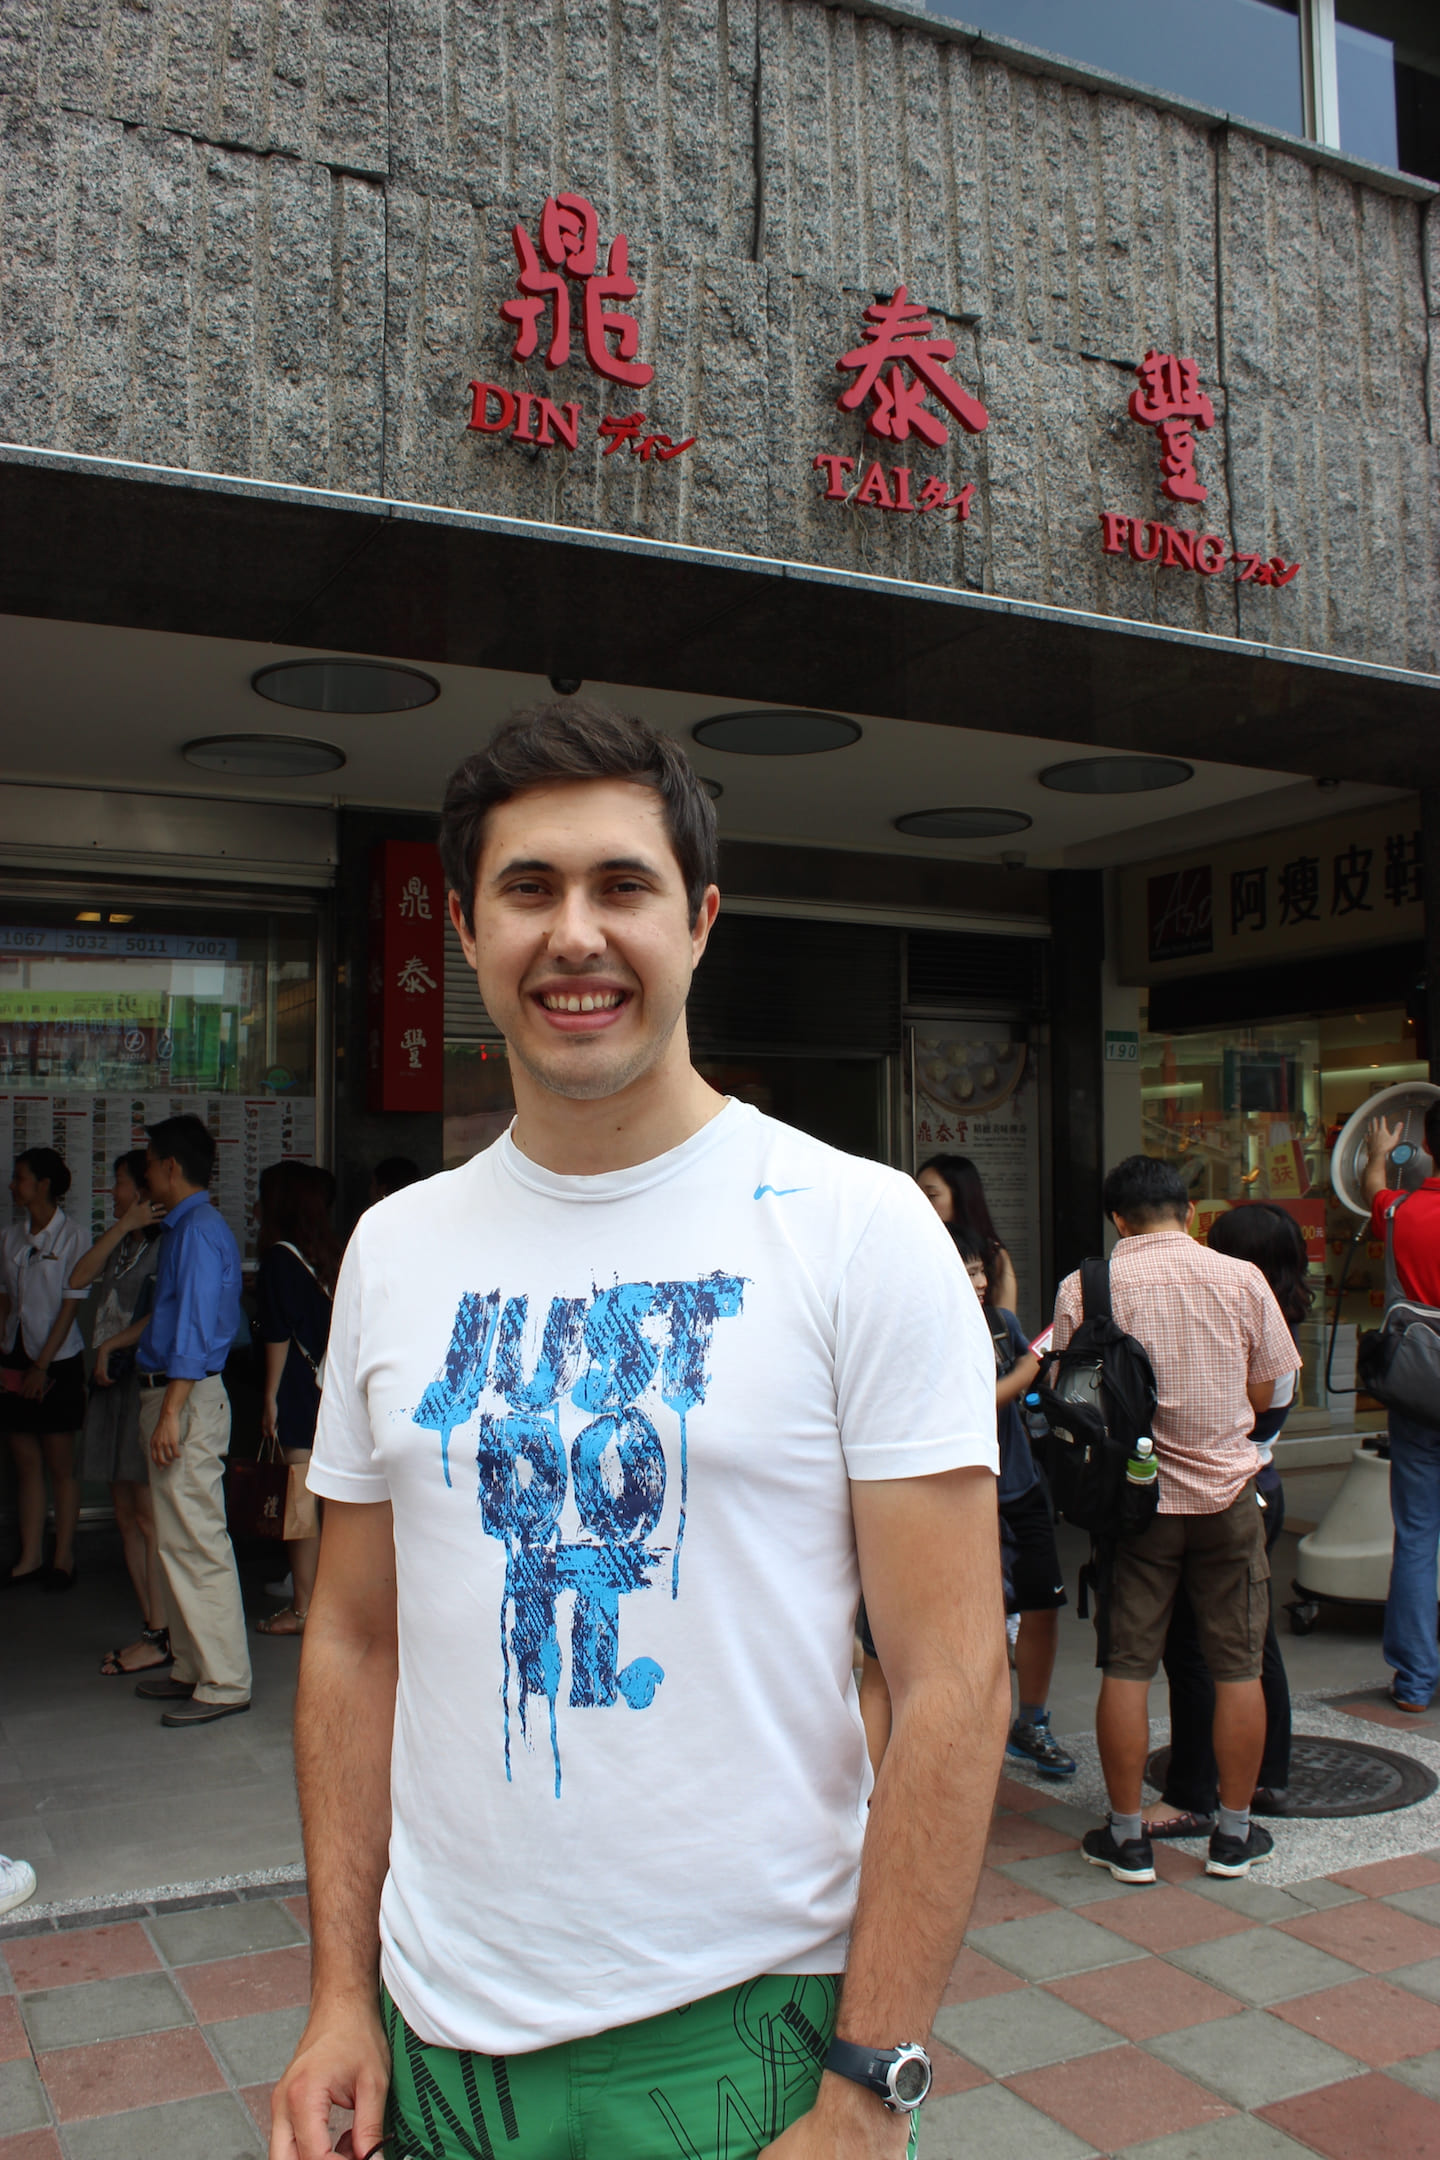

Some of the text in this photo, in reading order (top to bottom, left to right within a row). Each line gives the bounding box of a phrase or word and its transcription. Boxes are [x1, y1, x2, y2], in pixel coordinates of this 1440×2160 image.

[500, 192, 654, 389] 鼎
[836, 285, 989, 448] 泰
[467, 380, 582, 451] DIN
[813, 453, 915, 514] TAI
[1099, 511, 1227, 576] FUNG
[2, 931, 227, 957] 1067 3032 5011 7002
[397, 876, 437, 1069] 鼎泰豐
[1109, 1043, 1136, 1058] 190
[412, 1272, 746, 1428] JUST
[478, 1405, 667, 1546] DO
